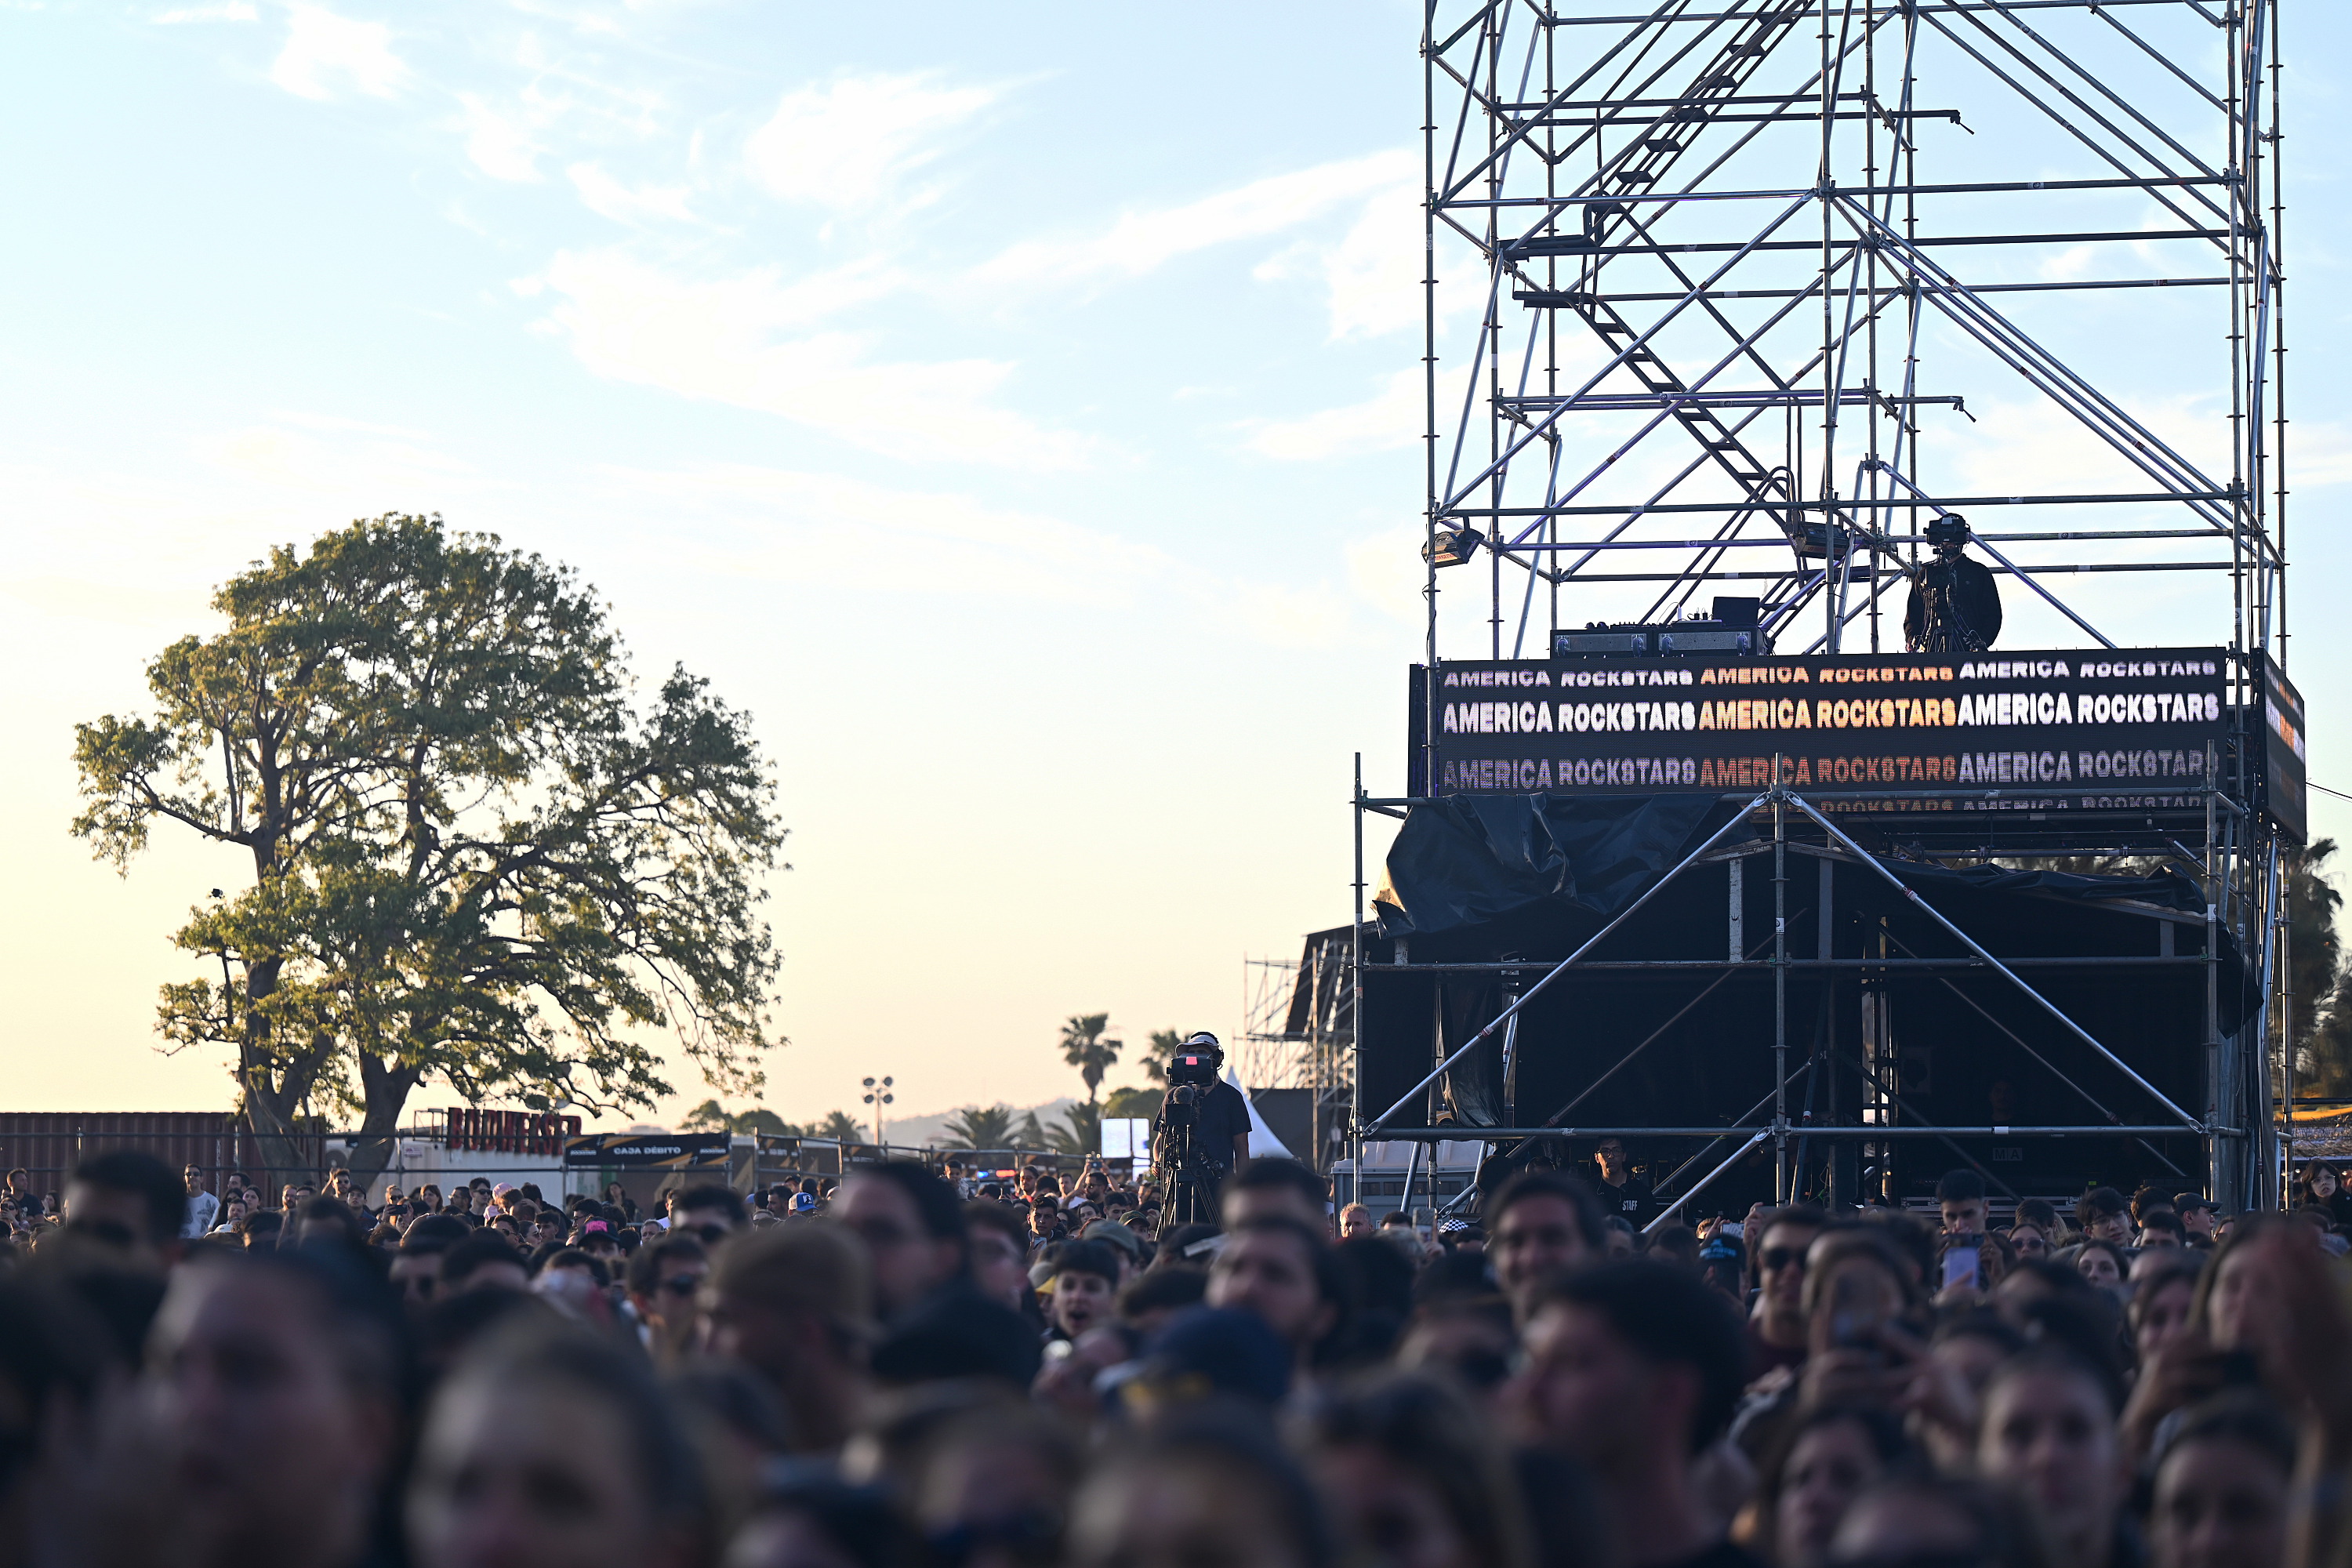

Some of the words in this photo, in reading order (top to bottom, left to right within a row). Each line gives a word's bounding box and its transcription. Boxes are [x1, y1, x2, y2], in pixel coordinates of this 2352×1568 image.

[1443, 670, 1552, 688] AMERICA
[1560, 669, 1693, 687] ROCKSTARS
[1700, 666, 1809, 684] AMERICA
[1819, 666, 1955, 684] ROCKSTARS
[1959, 661, 2071, 680] AMERICA
[2080, 660, 2216, 678] ROCKSTARS
[1443, 701, 1554, 734] AMERICA
[1557, 701, 1696, 732] ROCKSTARS
[1698, 698, 1812, 731] AMERICA
[1817, 697, 1957, 728] ROCKSTARS
[1958, 692, 2073, 727] AMERICA
[2078, 692, 2220, 724] ROCKSTARS
[1443, 757, 1554, 789] AMERICA
[1558, 756, 1697, 786] ROCKSTARS
[1700, 756, 1813, 787] AMERICA
[1817, 755, 1957, 783] ROCKSTARS
[1958, 751, 2072, 783] AMERICA
[613, 1146, 642, 1155] CAJA
[1622, 1200, 1638, 1211] STAFF
